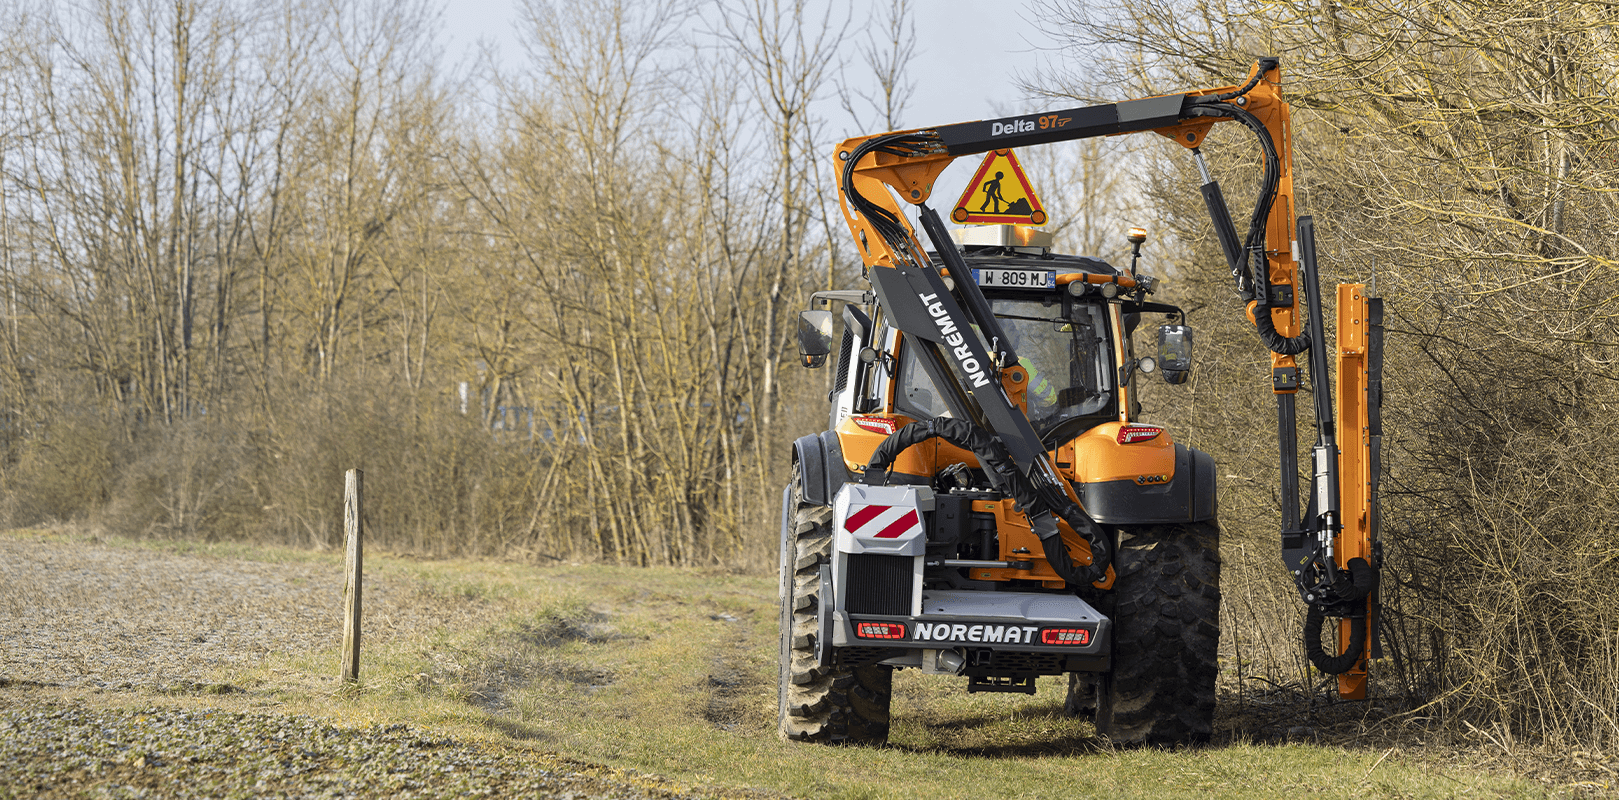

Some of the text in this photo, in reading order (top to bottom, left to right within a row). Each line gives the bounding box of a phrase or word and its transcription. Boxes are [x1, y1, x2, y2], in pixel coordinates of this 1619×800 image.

[991, 115, 1059, 136] Delta 97
[985, 271, 1048, 286] W 809 MJ
[919, 292, 990, 388] NOREMAT
[914, 622, 1038, 644] NOREMAT
